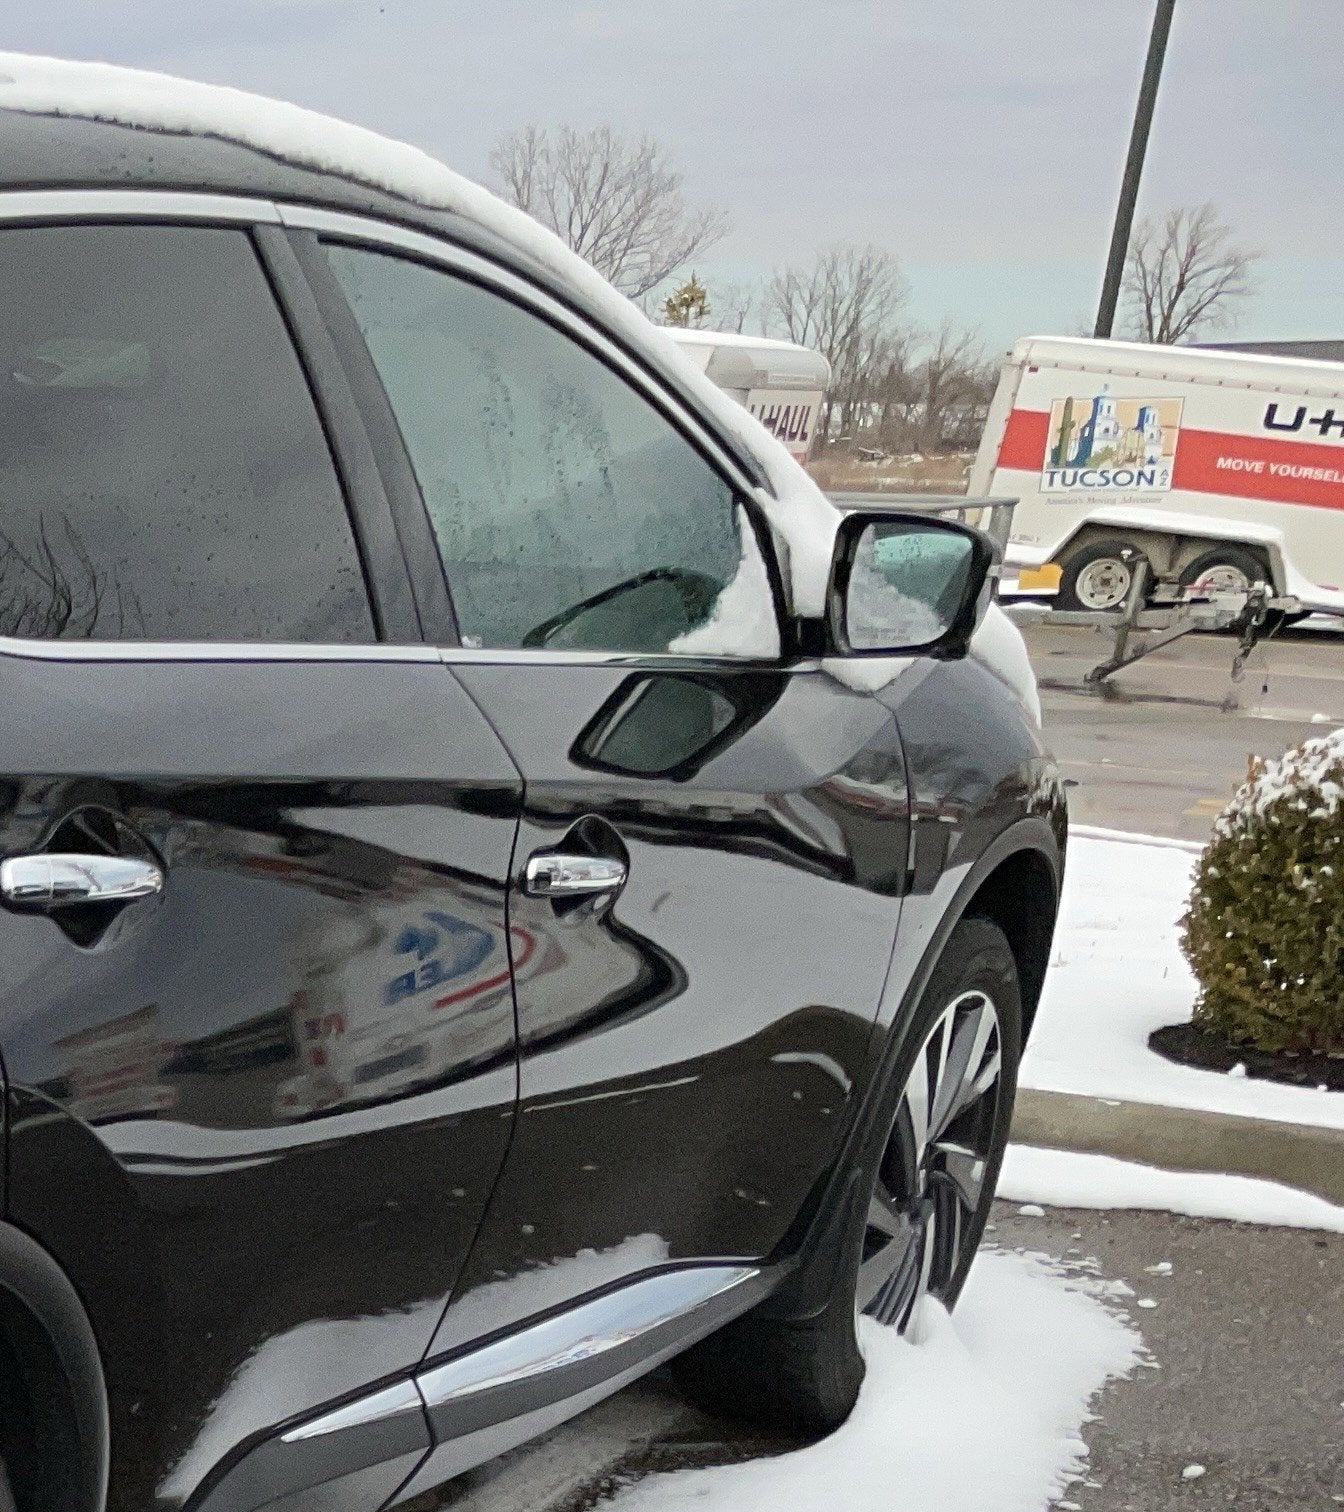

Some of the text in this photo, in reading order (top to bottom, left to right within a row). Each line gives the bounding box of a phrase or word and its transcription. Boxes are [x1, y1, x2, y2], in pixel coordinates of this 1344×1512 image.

[1045, 469, 1156, 487] TUCSON
[1216, 457, 1344, 483] MOVE YOURSEL
